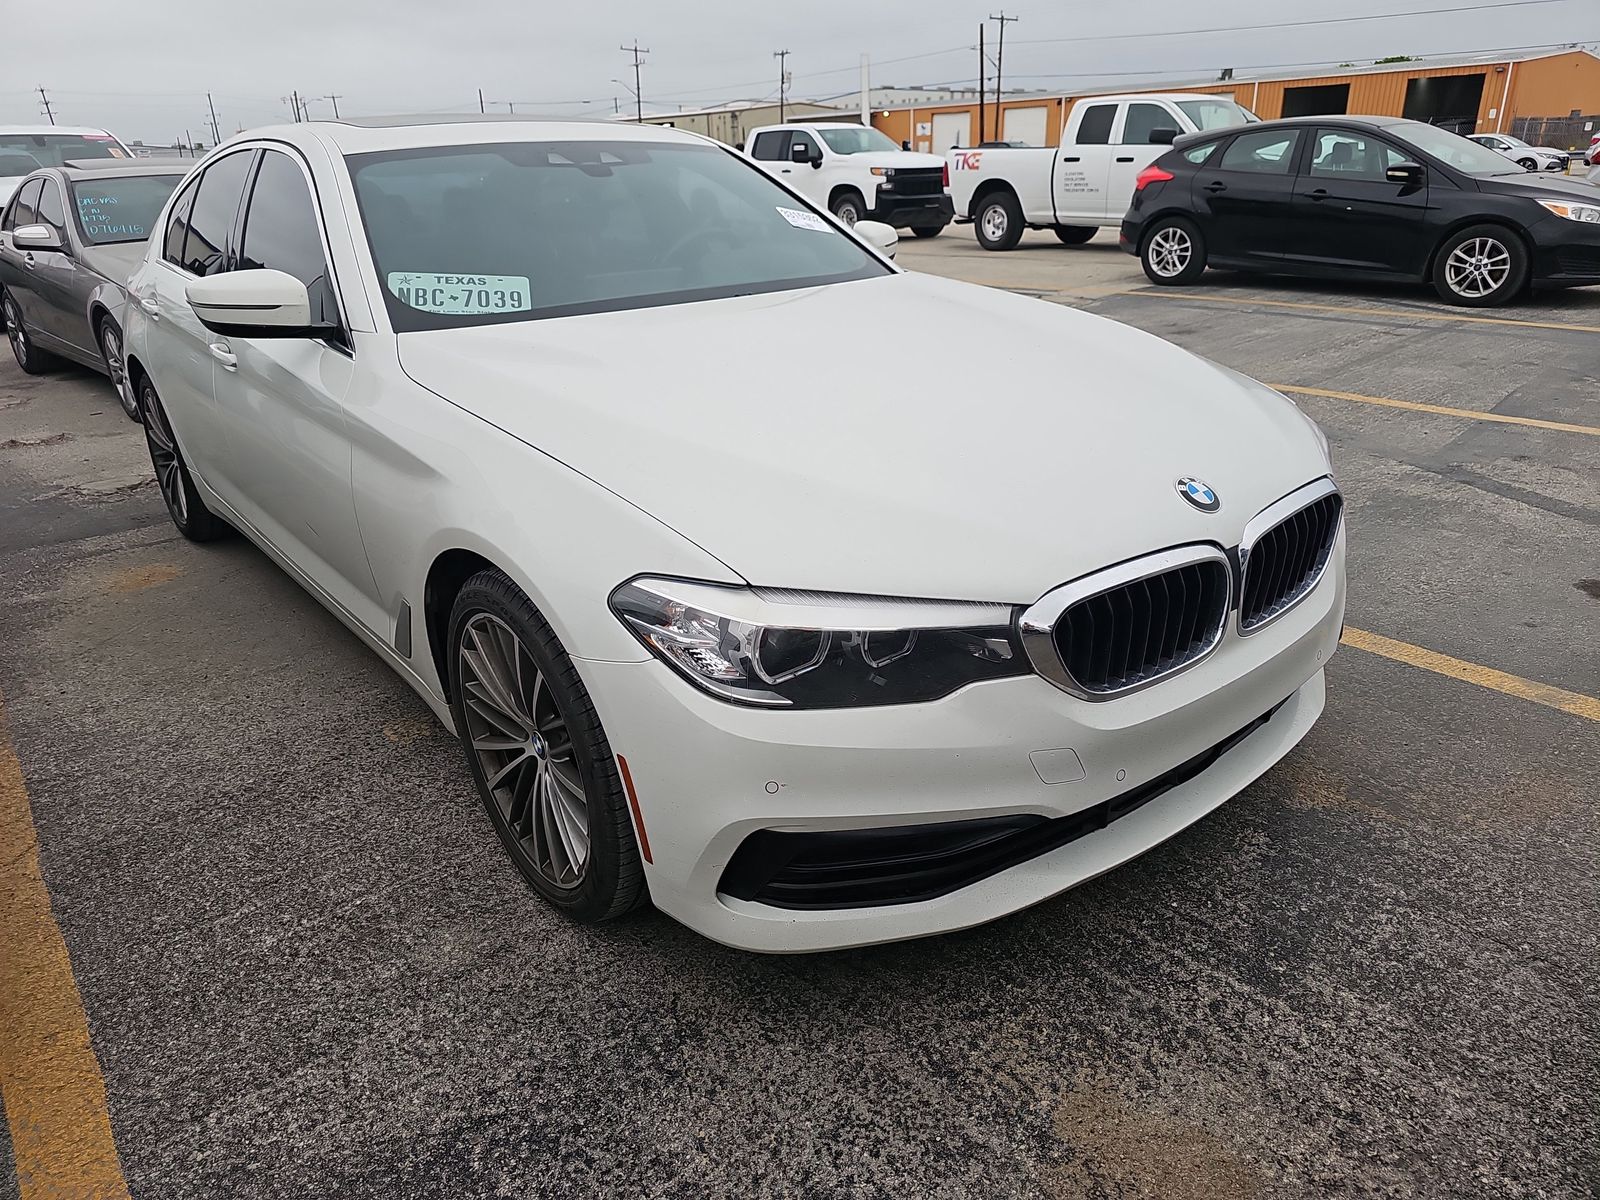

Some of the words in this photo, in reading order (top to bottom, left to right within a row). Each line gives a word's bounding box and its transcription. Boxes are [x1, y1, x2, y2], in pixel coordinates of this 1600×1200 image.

[954, 152, 983, 170] TKE
[434, 275, 488, 286] TEXAS
[397, 287, 445, 307] NBC
[460, 289, 523, 309] 7039
